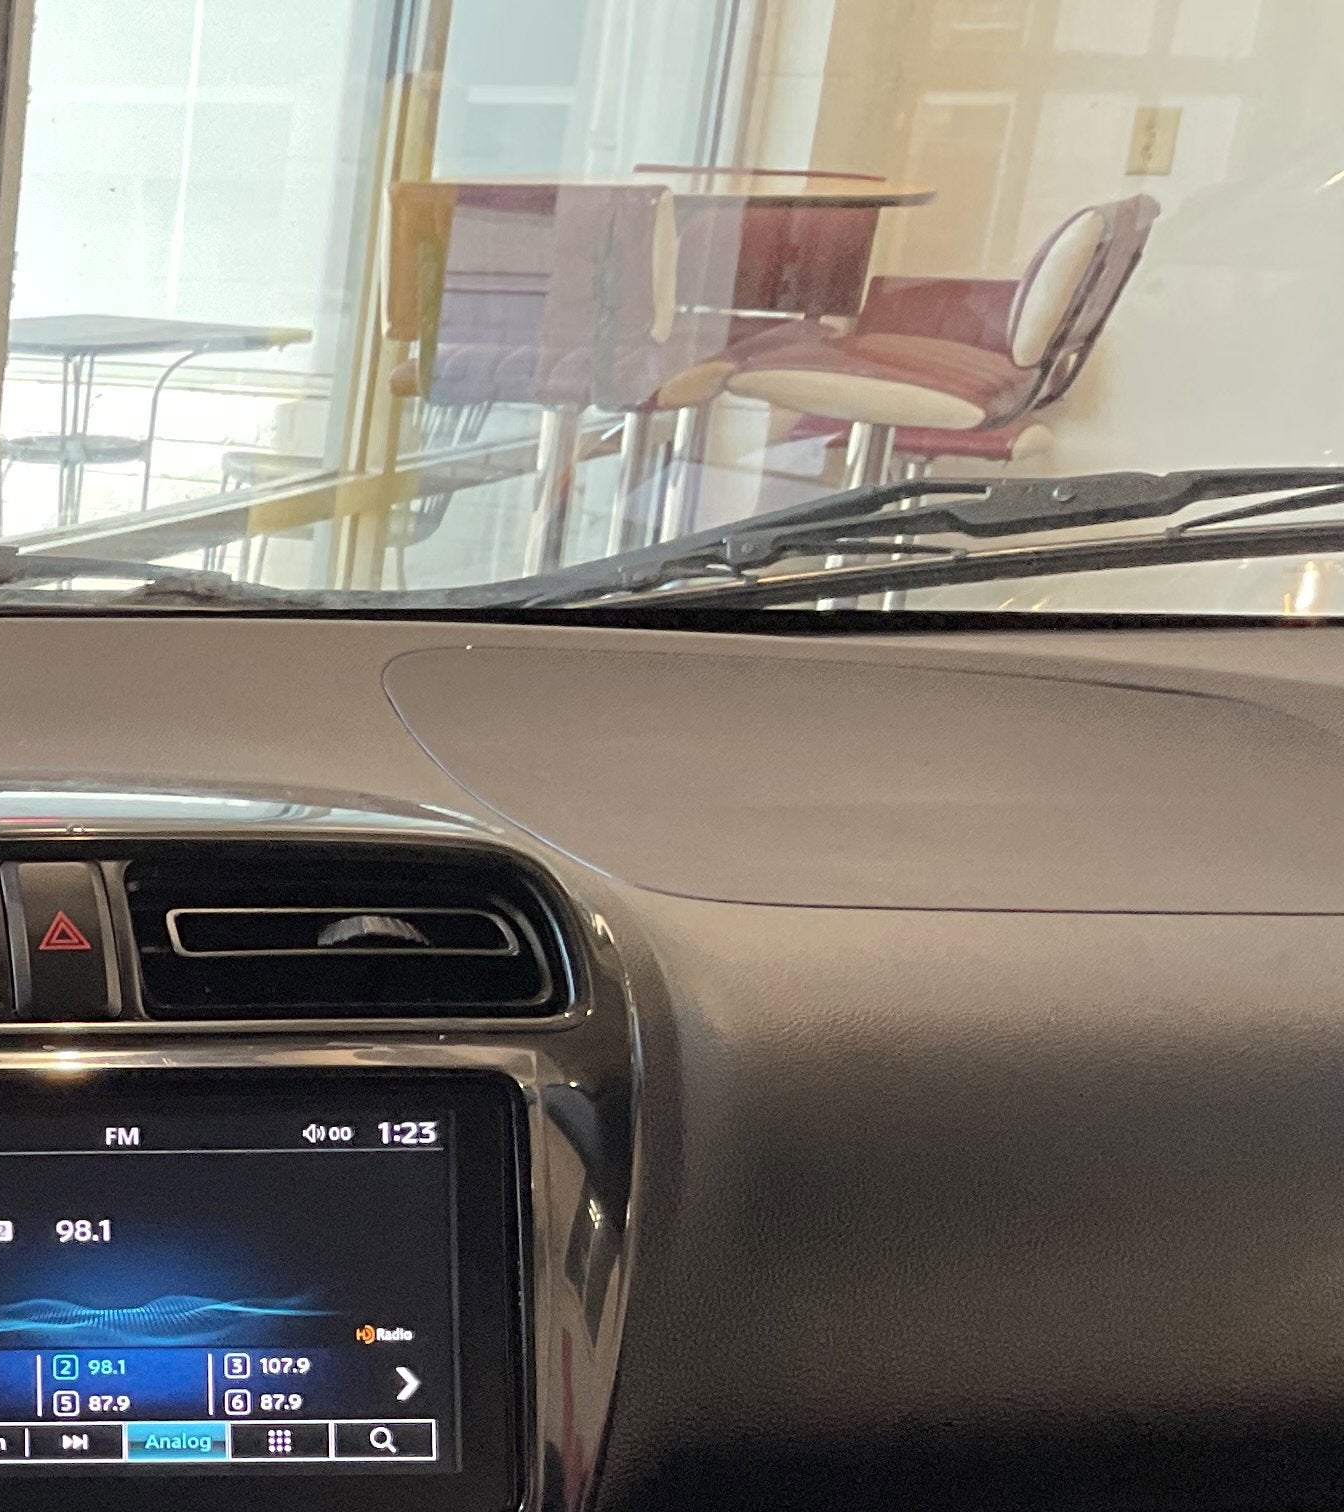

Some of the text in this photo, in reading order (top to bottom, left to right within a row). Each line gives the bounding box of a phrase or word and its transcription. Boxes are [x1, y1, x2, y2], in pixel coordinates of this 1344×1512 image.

[105, 1127, 140, 1146] FM
[377, 1121, 438, 1144] 1:23
[55, 1219, 112, 1242] 98.1
[375, 1327, 413, 1342] Radio
[88, 1359, 127, 1375] 98.1
[260, 1357, 311, 1374] 107.9
[88, 1395, 131, 1412] 87.9
[260, 1394, 303, 1411] 87.9
[145, 1434, 212, 1452] Analog
